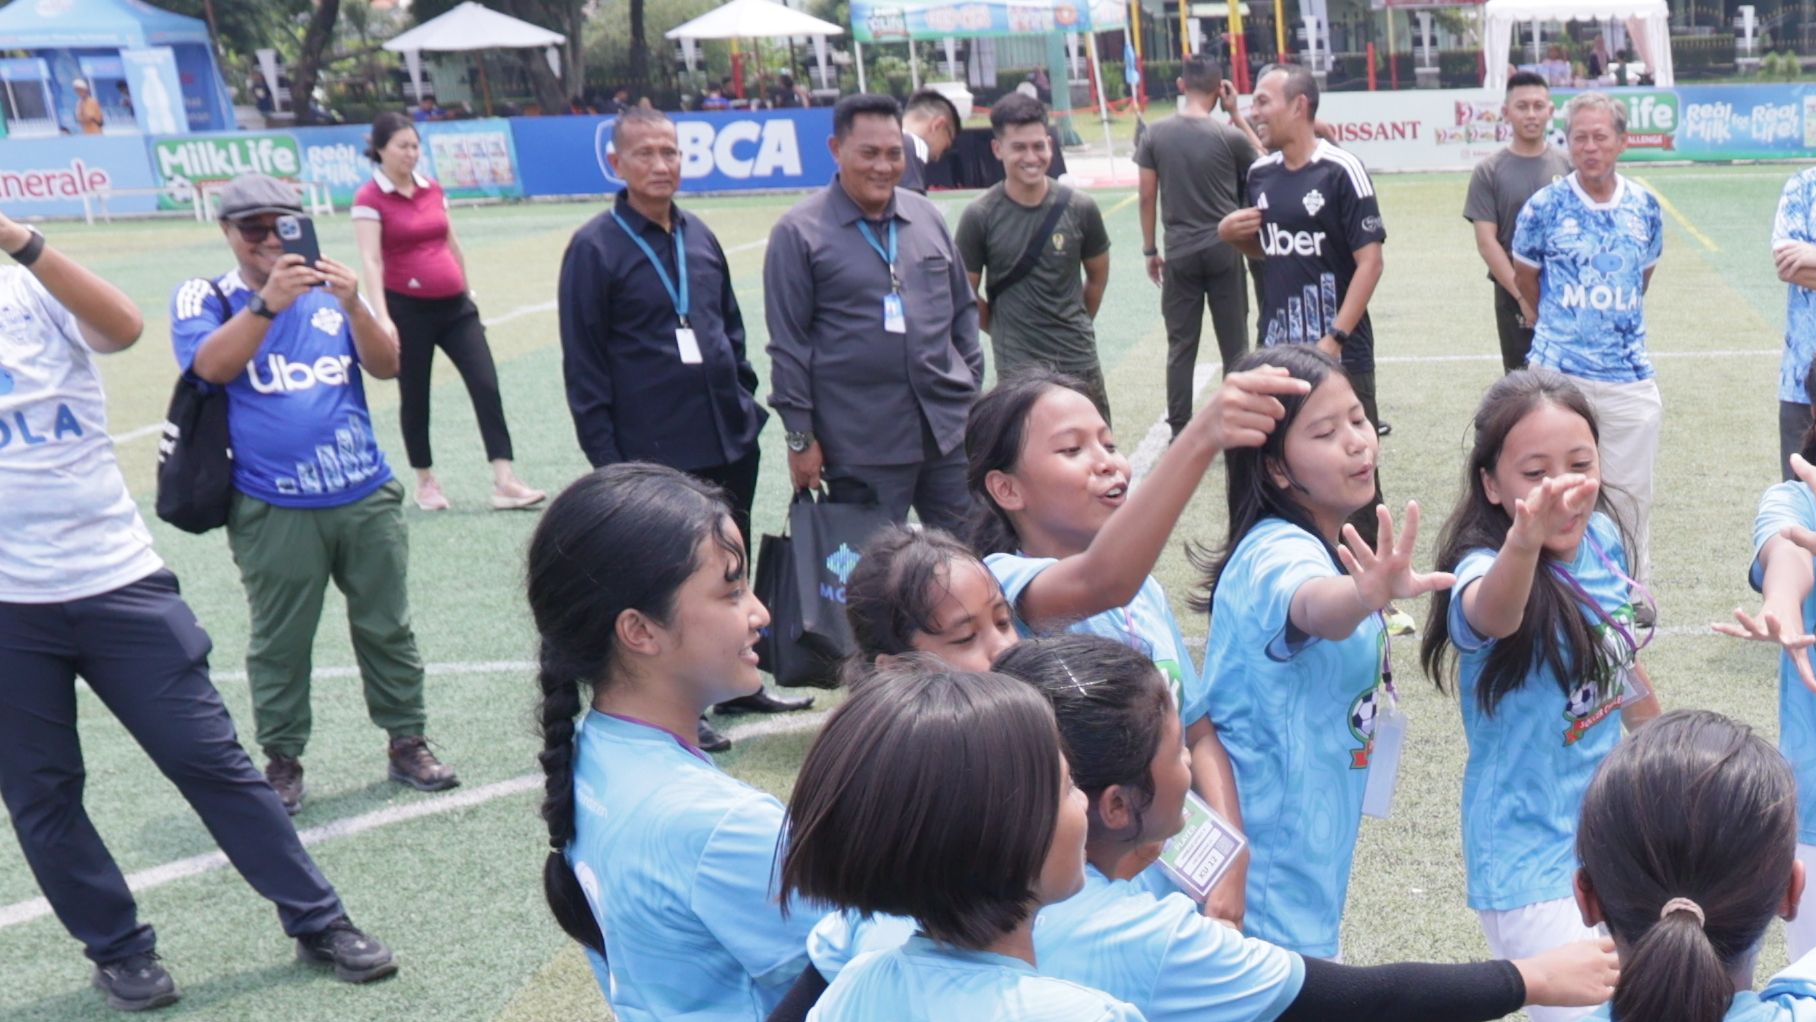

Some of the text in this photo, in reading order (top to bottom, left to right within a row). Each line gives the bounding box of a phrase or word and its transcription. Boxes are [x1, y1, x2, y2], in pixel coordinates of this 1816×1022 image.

[157, 138, 298, 180] MilkLife
[676, 118, 803, 179] BCA
[0, 160, 107, 199] nerale
[1258, 222, 1326, 258] Uber
[246, 353, 353, 395] Uber
